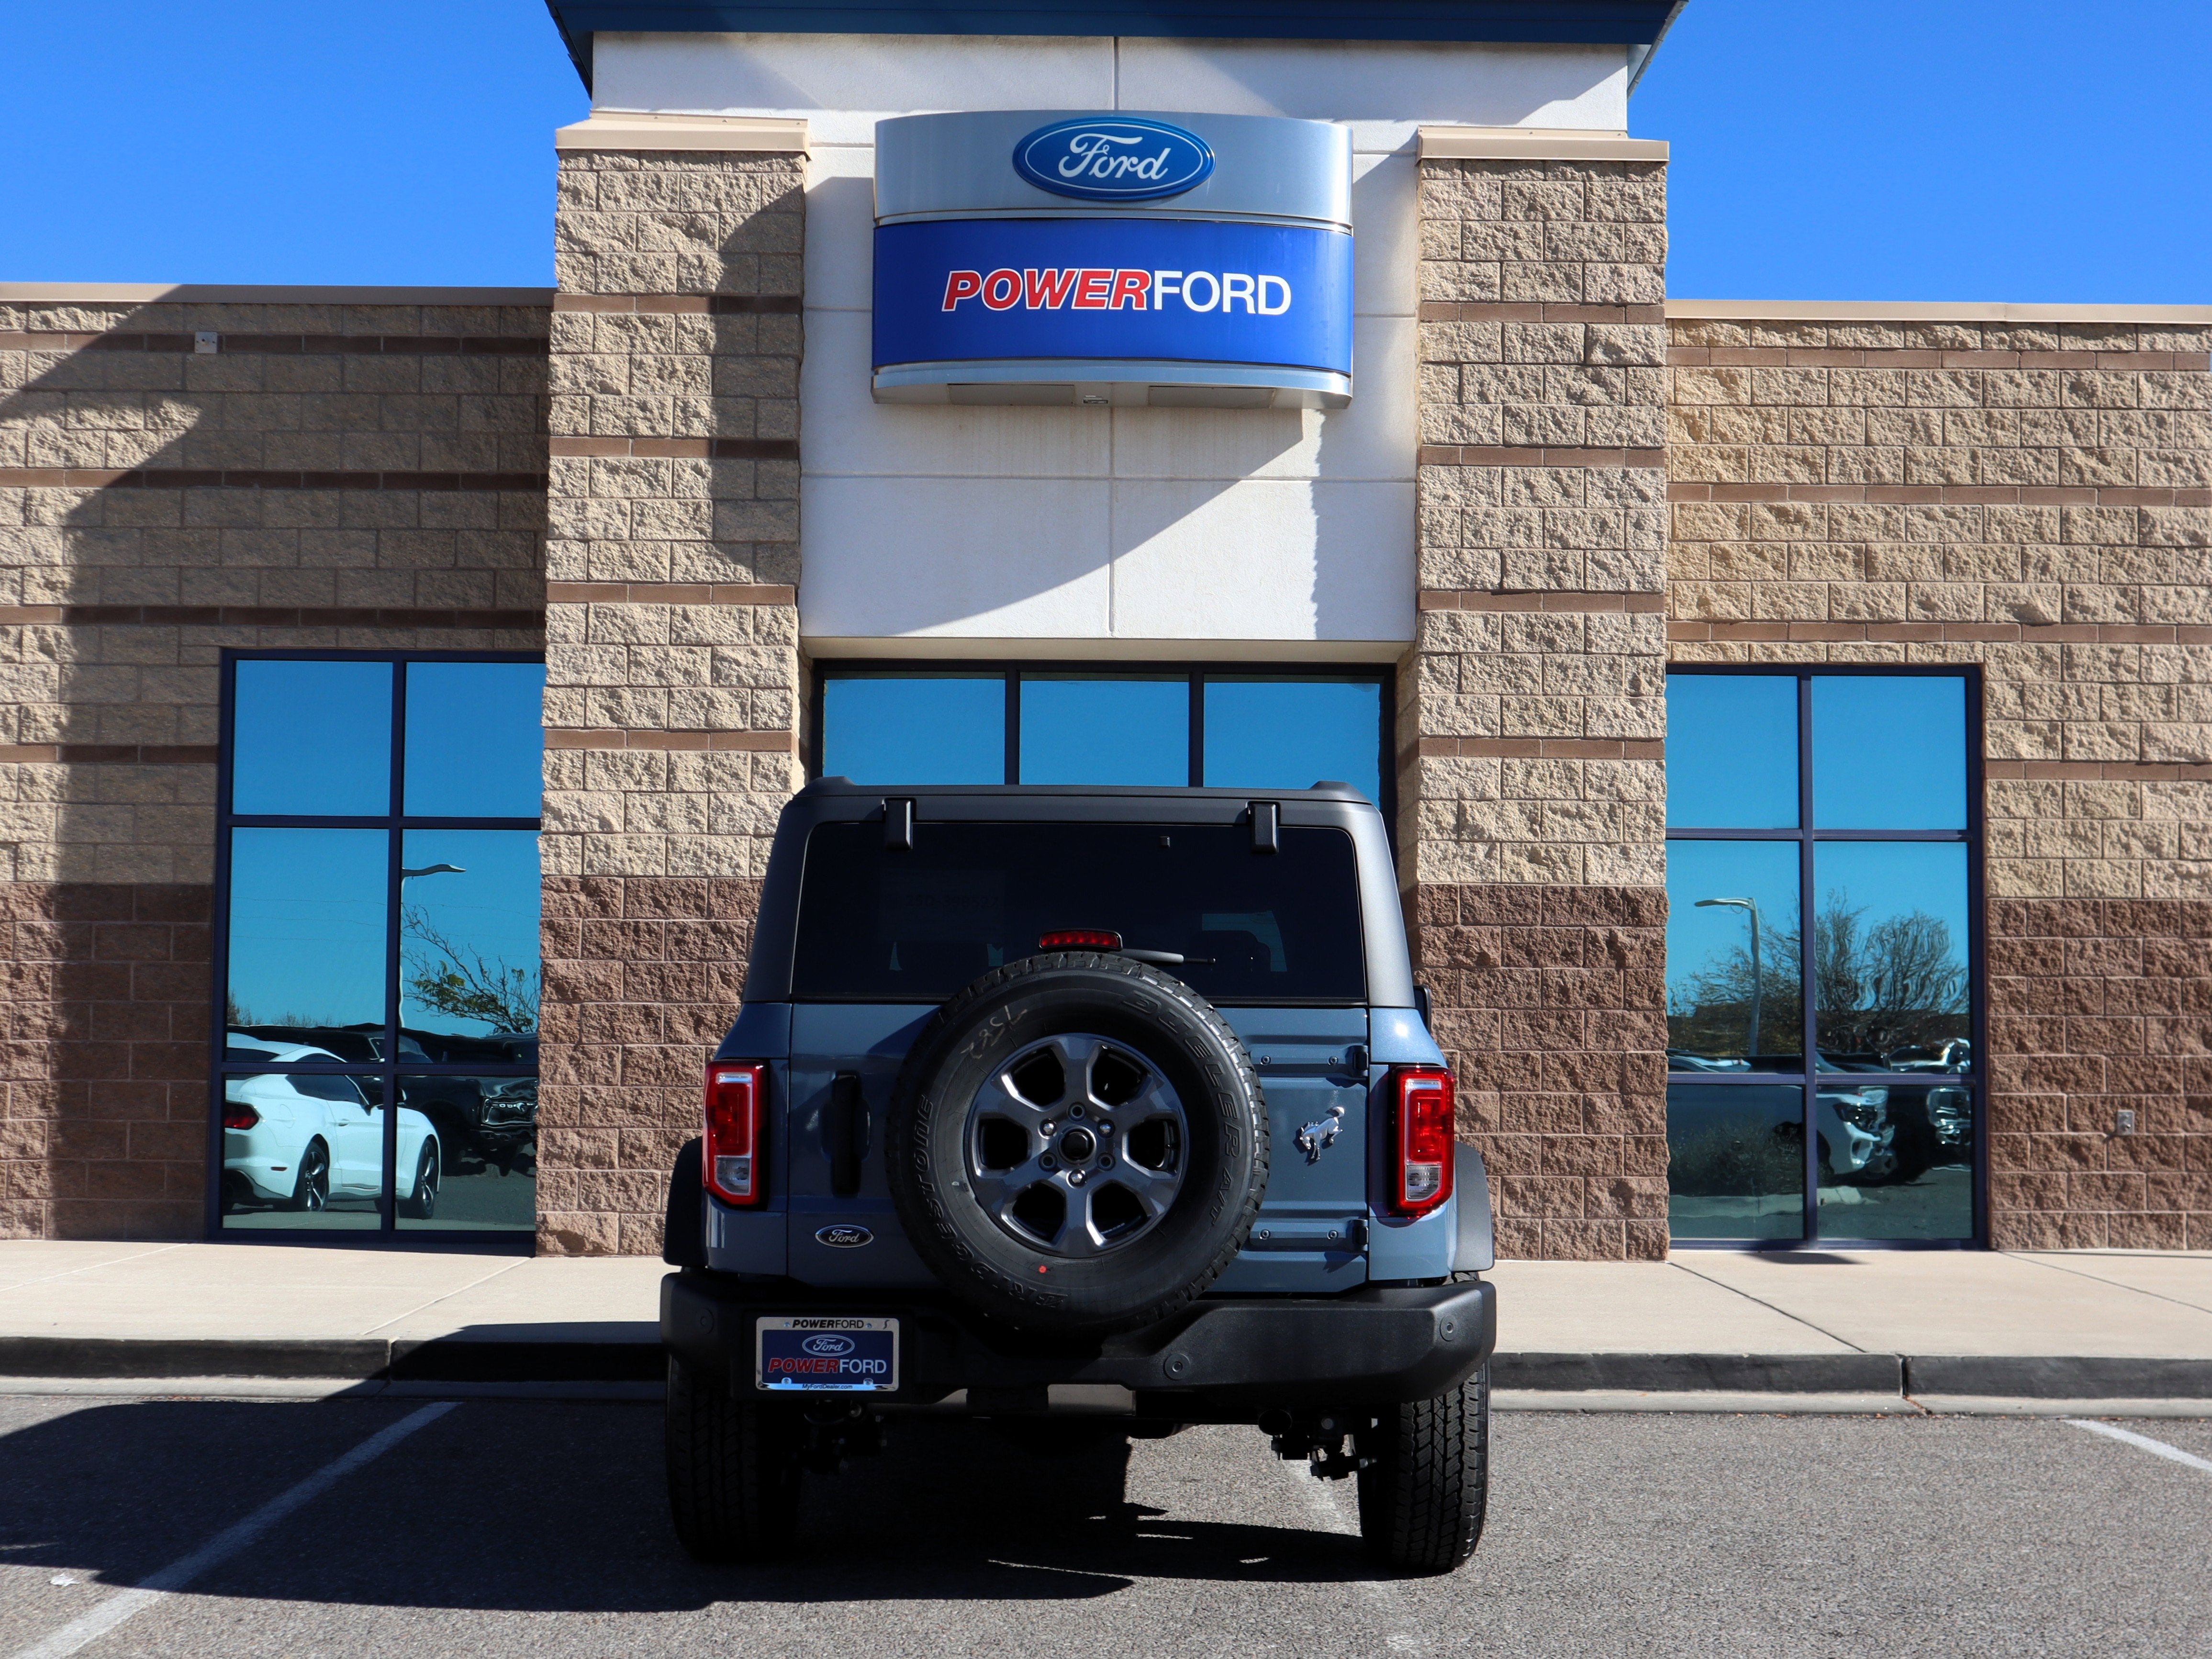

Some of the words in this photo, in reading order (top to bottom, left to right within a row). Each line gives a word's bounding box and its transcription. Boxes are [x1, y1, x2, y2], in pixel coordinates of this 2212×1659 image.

[1058, 133, 1169, 180] Ford
[1121, 989, 1243, 1160] DUELER
[1209, 1165, 1241, 1227] A/T
[828, 1229, 860, 1243] Ford
[792, 1319, 864, 1329] POWERFORD
[813, 1338, 843, 1352] Ford
[768, 1358, 887, 1374] POWERFORD
